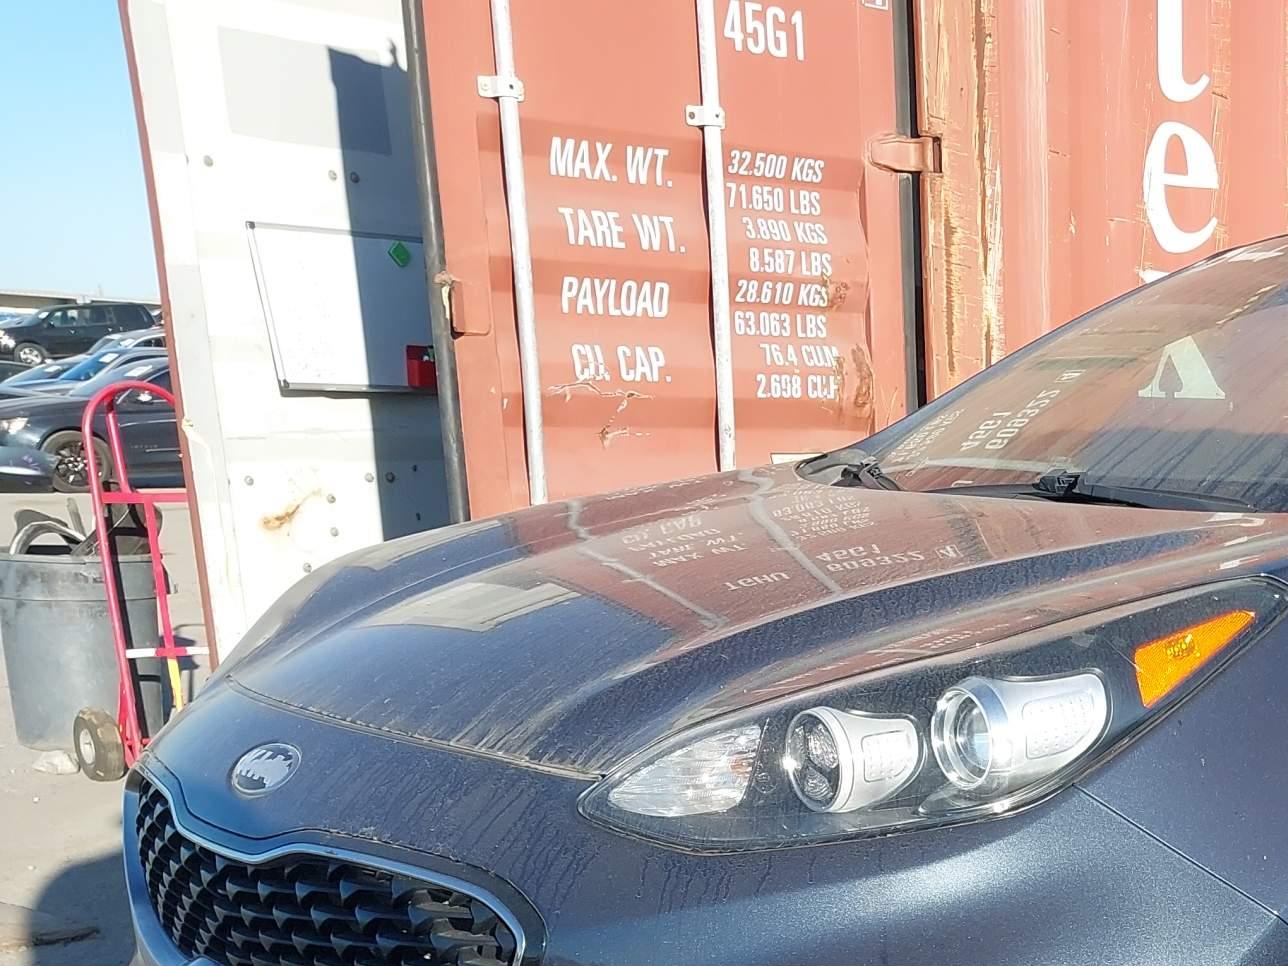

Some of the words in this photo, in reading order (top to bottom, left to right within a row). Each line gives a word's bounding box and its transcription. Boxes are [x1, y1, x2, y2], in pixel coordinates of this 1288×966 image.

[723, 0, 805, 61] 45G1
[549, 136, 618, 182] MAX.
[626, 145, 673, 188] WT.
[727, 149, 788, 179] 32.500
[791, 157, 825, 183] KGS
[725, 182, 784, 213] 71.650
[789, 189, 821, 216] LBS
[557, 206, 626, 249] TARE
[631, 213, 687, 253] WT.
[742, 216, 792, 242] 3.890
[793, 220, 829, 245] KGS
[749, 247, 796, 275] 8.587
[800, 251, 833, 278] LBS
[561, 275, 671, 318] PAYLOAD
[735, 279, 794, 305] 28.610
[797, 283, 829, 307] KGS
[734, 310, 791, 337] 63.063
[796, 313, 828, 338] LBS
[570, 343, 611, 382] CU.
[616, 345, 673, 383] CAP.
[759, 343, 798, 367] 76.4
[756, 373, 802, 398] 2.698
